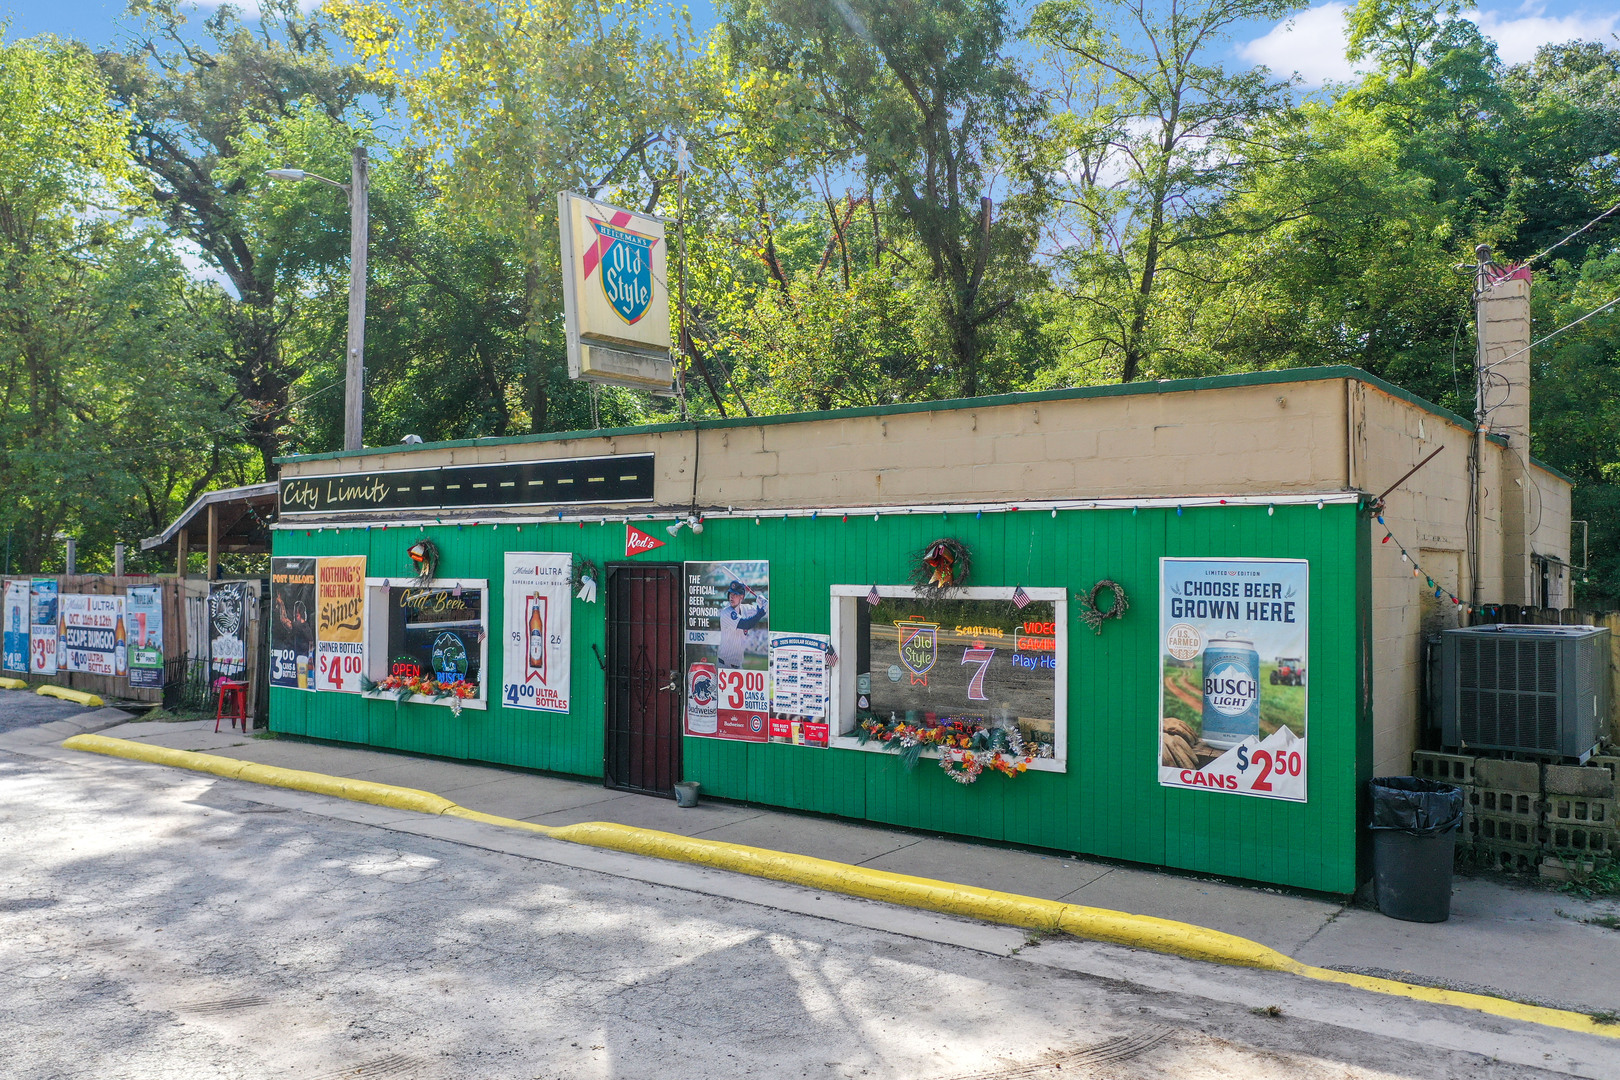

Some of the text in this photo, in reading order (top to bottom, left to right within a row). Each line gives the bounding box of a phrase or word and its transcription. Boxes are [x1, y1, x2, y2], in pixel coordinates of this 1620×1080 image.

[613, 242, 641, 275] Old
[607, 267, 648, 314] Style
[283, 476, 390, 510] City Limits
[628, 532, 655, 549] Red's
[320, 566, 361, 583] NOTHING'S
[540, 567, 563, 576] ULTRA
[272, 574, 315, 584] POST MALONE
[688, 574, 701, 584] THE
[320, 584, 361, 598] FINER THAN A
[688, 585, 716, 595] OFFICIAL
[1184, 580, 1282, 599] CHOOSE BEER
[92, 601, 115, 612] ULTRA
[400, 588, 467, 613] Cold Beer
[688, 596, 705, 606] BEER
[320, 597, 363, 631] Shiner
[688, 607, 719, 617] SPONSOR
[1171, 597, 1296, 624] GROWN HERE
[94, 614, 99, 627] &
[688, 617, 710, 628] OF THE
[511, 631, 522, 642] 95
[688, 631, 705, 642] CUBS
[955, 624, 1005, 638] Seagram's
[1177, 630, 1190, 639] U.S.
[66, 628, 115, 650] ESCAPE BURGOO
[550, 634, 562, 644] 2.6
[913, 634, 932, 649] Old
[1169, 637, 1199, 647] FARMED
[318, 641, 363, 655] SHINER BOTTLES
[88, 652, 104, 663] ULTRA
[905, 646, 932, 668] Style
[1012, 654, 1037, 671] Play
[88, 662, 111, 673] BOTTLES
[392, 662, 420, 677] OPEN
[960, 647, 996, 701] 7
[436, 671, 464, 684] BUSCH
[535, 688, 558, 698] ULTRA
[1205, 678, 1257, 699] BUSCH
[744, 691, 765, 701] CANS &
[1213, 696, 1248, 707] LIGHT
[535, 697, 568, 709] BOTTLES
[744, 700, 768, 710] BOTTLES
[1180, 770, 1238, 790] CANS
